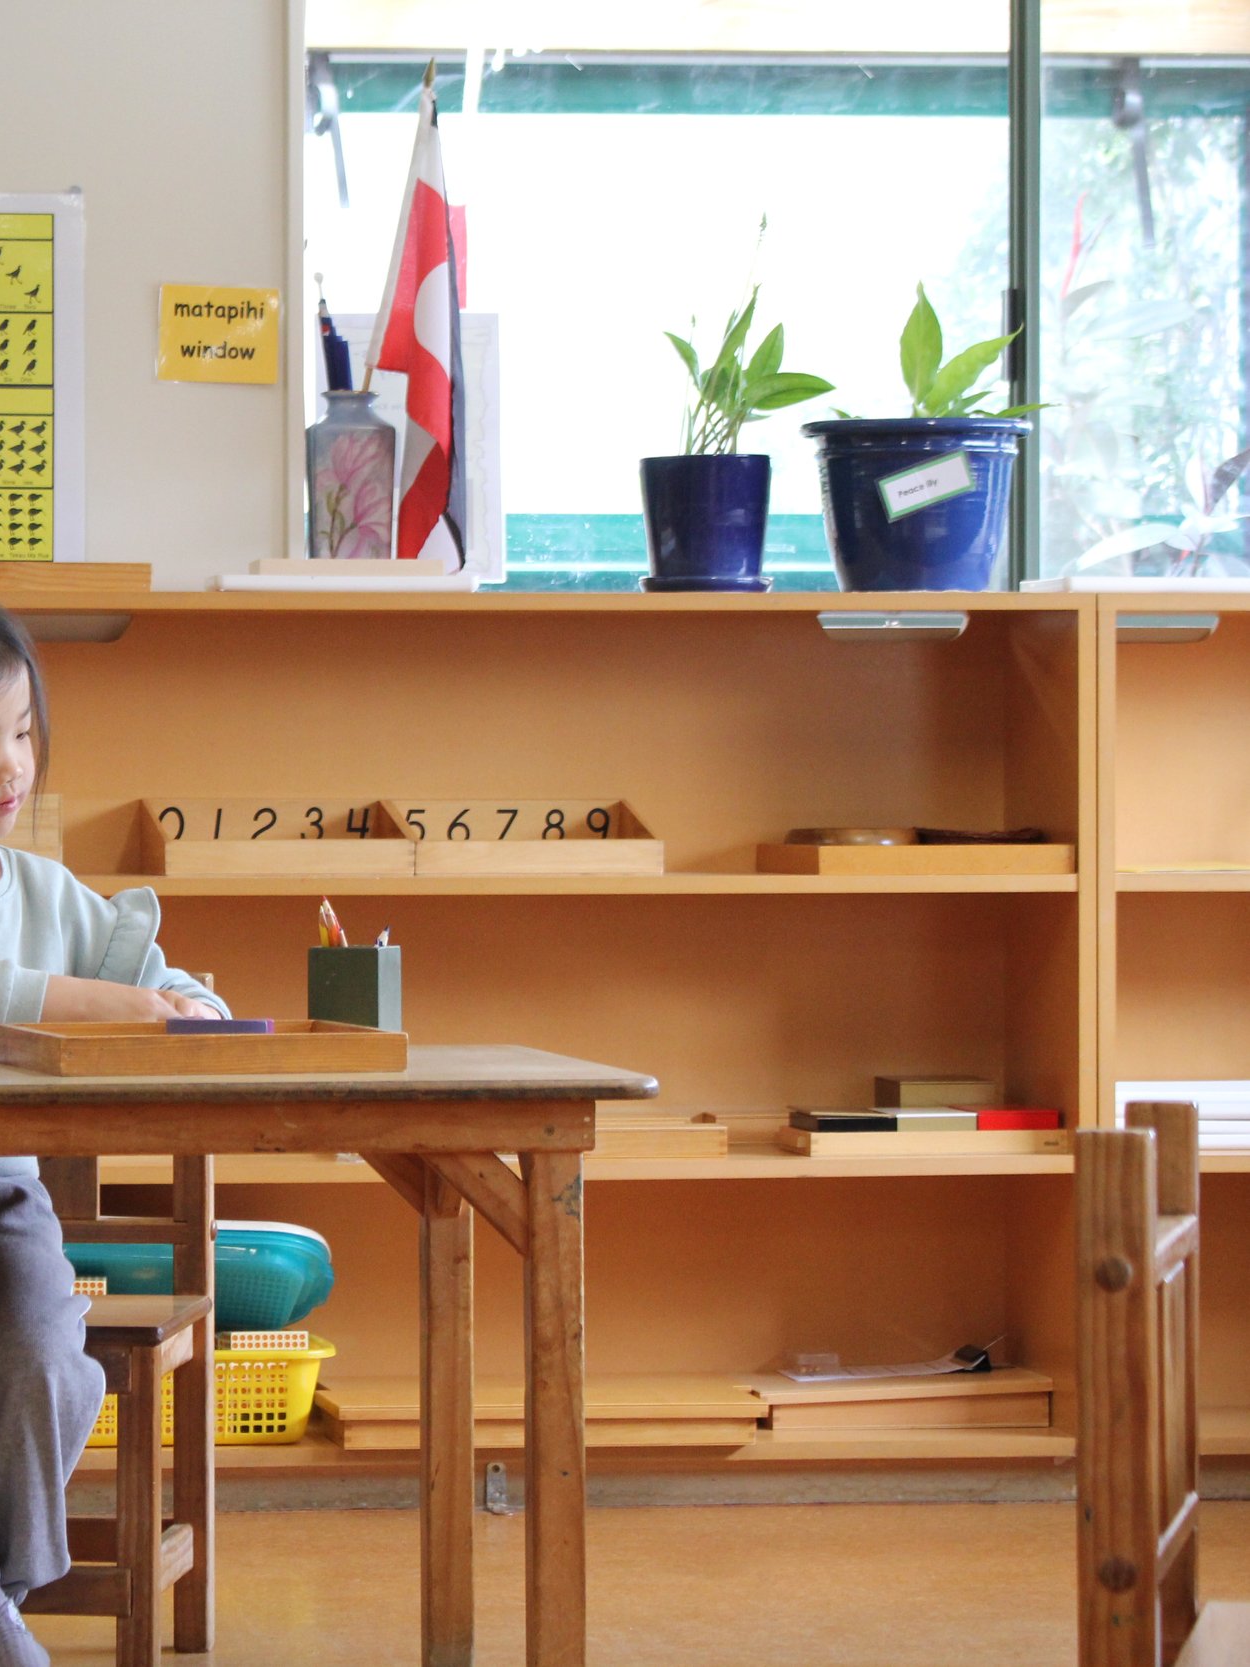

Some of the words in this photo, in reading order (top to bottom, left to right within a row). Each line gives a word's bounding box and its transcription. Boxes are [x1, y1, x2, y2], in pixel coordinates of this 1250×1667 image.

[174, 301, 265, 325] matapihi
[181, 340, 255, 360] window
[158, 806, 185, 840] 0
[213, 808, 223, 840] 1
[250, 807, 277, 840] 2
[300, 807, 324, 840] 3
[346, 808, 370, 840] 4
[405, 808, 426, 840] 5
[446, 808, 471, 840] 6
[496, 808, 519, 840] 7
[541, 808, 565, 840] 8
[586, 807, 610, 840] 9
